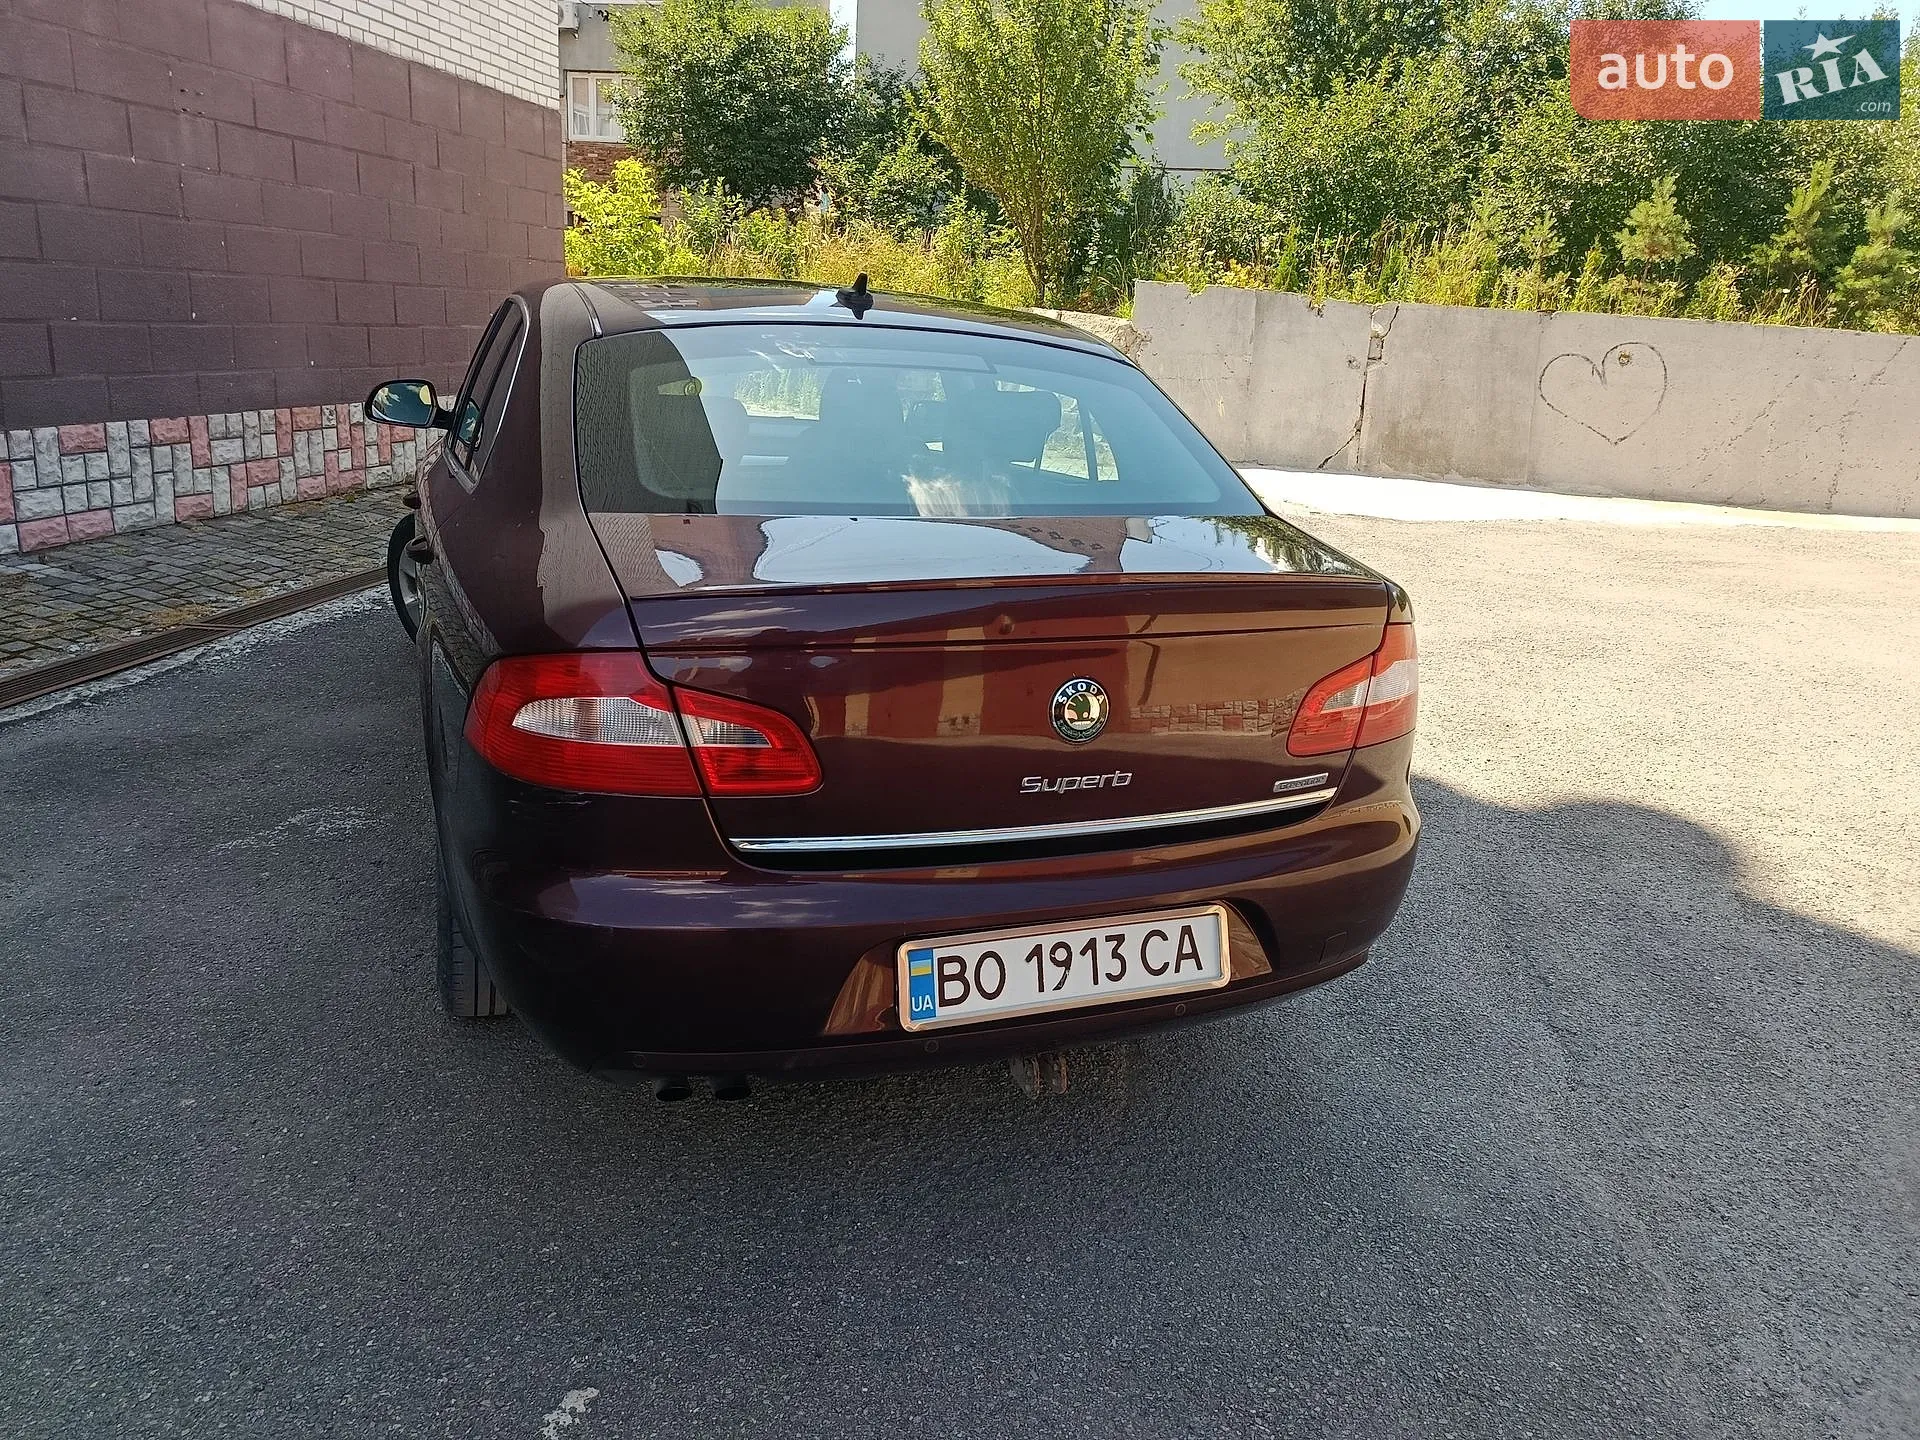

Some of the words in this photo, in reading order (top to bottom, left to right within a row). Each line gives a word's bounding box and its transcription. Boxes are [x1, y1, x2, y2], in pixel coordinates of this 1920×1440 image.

[1019, 771, 1132, 795] Superb
[936, 950, 1006, 1008] BO
[1025, 933, 1127, 993] 1913
[1140, 924, 1203, 977] CA
[911, 994, 933, 1012] UA
